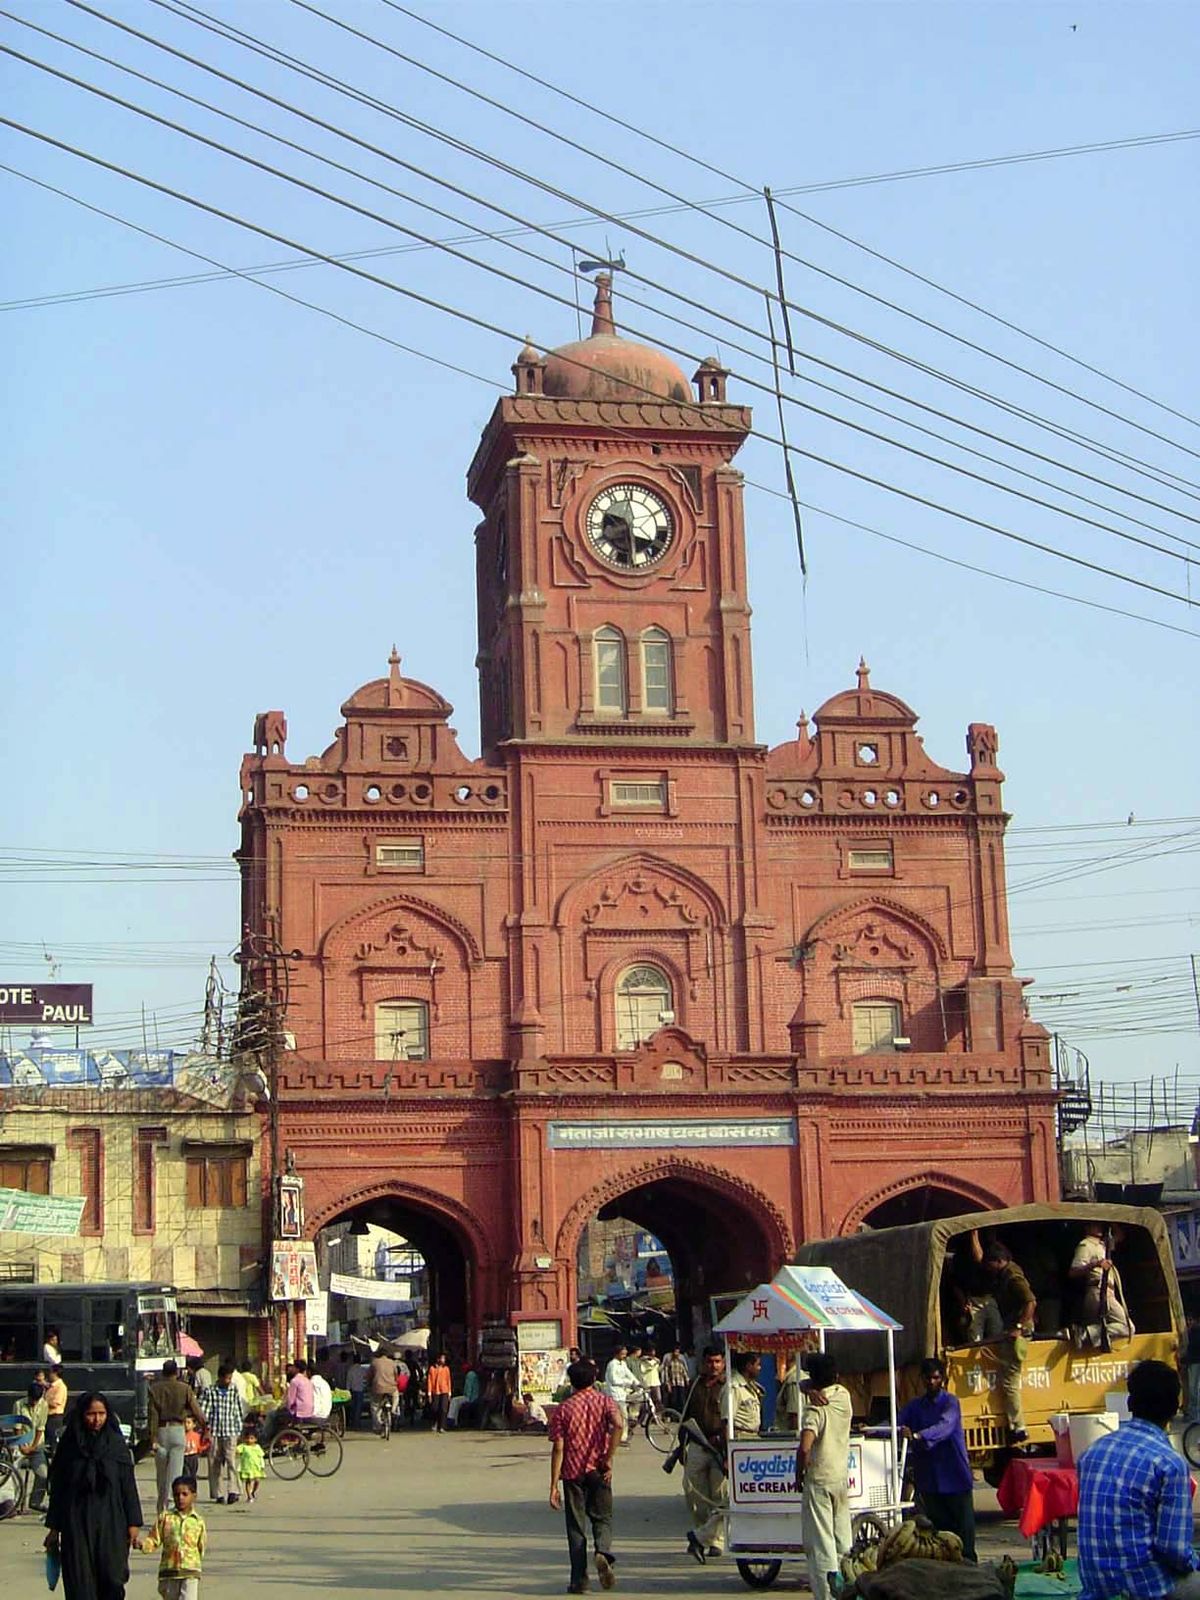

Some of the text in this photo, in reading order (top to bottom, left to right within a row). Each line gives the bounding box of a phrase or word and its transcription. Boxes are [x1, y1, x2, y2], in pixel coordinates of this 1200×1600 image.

[0, 988, 44, 1004] OTE
[42, 1005, 89, 1022] PAUL
[738, 1455, 797, 1481] Jagdish
[740, 1481, 799, 1493] ICE CREAM
